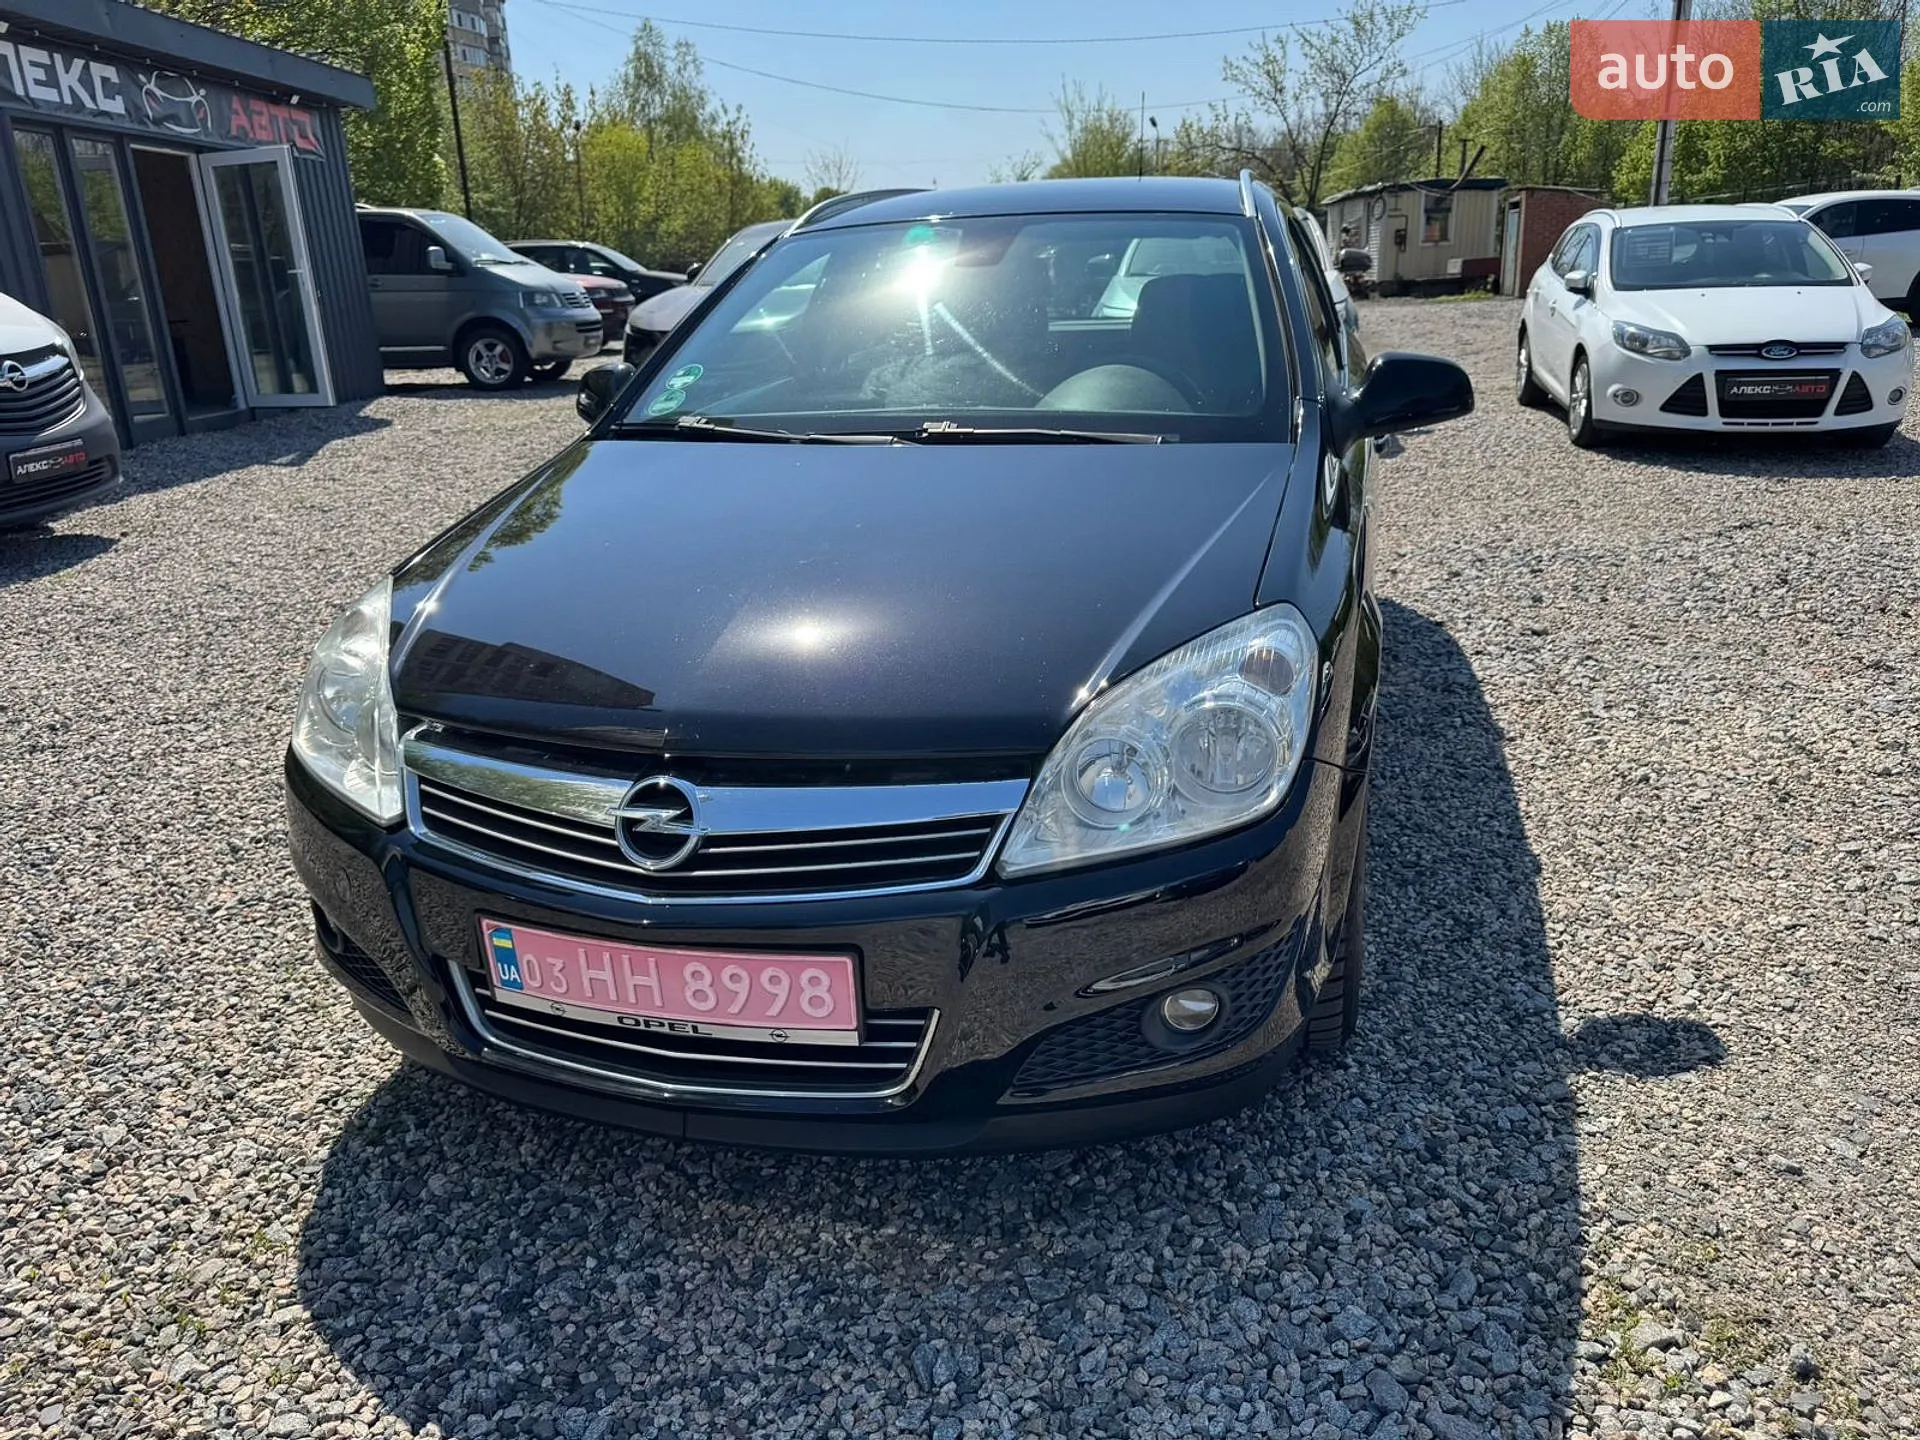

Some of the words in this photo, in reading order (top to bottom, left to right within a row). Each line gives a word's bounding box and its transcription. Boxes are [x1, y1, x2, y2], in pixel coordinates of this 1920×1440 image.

[230, 94, 318, 152] АВТО
[1730, 385, 1771, 395] АЛЕКС
[17, 460, 49, 476] АЛЕКС
[497, 962, 521, 983] UA
[522, 953, 569, 994] 03
[577, 948, 664, 1008] HH
[682, 961, 835, 1018] 8998
[616, 1015, 713, 1036] OPEL
